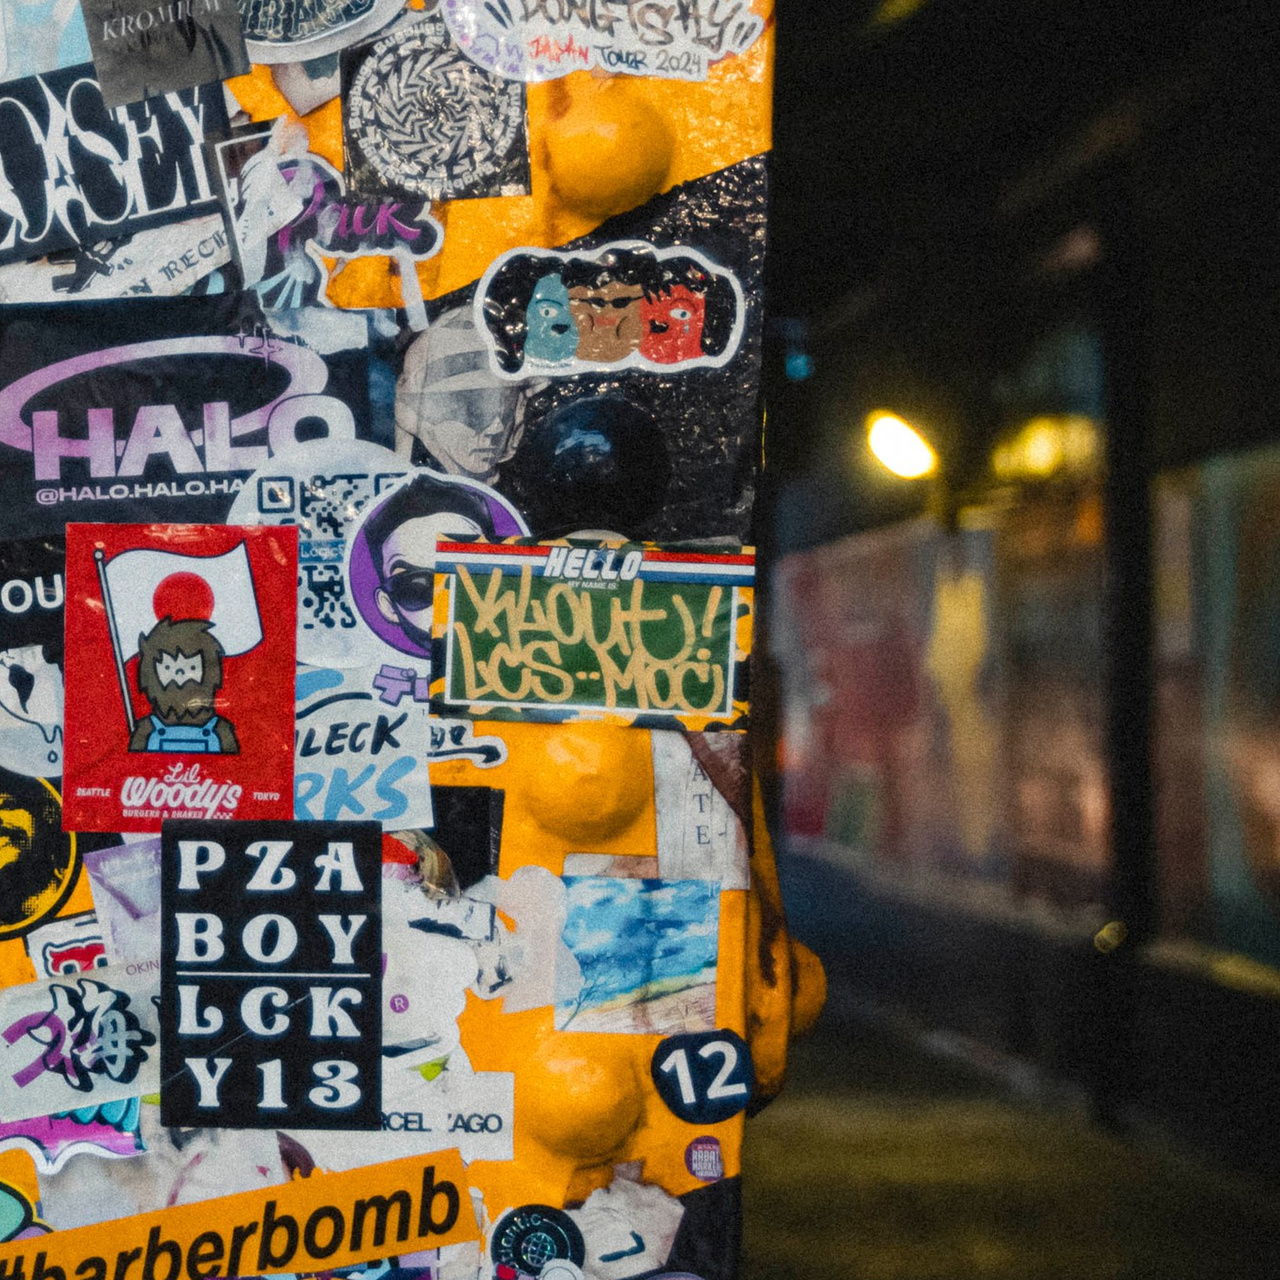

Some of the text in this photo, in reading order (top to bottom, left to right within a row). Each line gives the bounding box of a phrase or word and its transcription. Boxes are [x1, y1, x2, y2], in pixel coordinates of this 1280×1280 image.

[593, 44, 649, 69] TOUR
[656, 52, 701, 75] 2024
[32, 393, 356, 481] HALO
[543, 548, 643, 582] HELLO
[76, 787, 112, 798] SEATTLE
[120, 776, 243, 820] Woody's
[252, 792, 281, 802] TOKYO
[122, 809, 161, 819] BURGERS
[659, 1040, 748, 1106] 12
